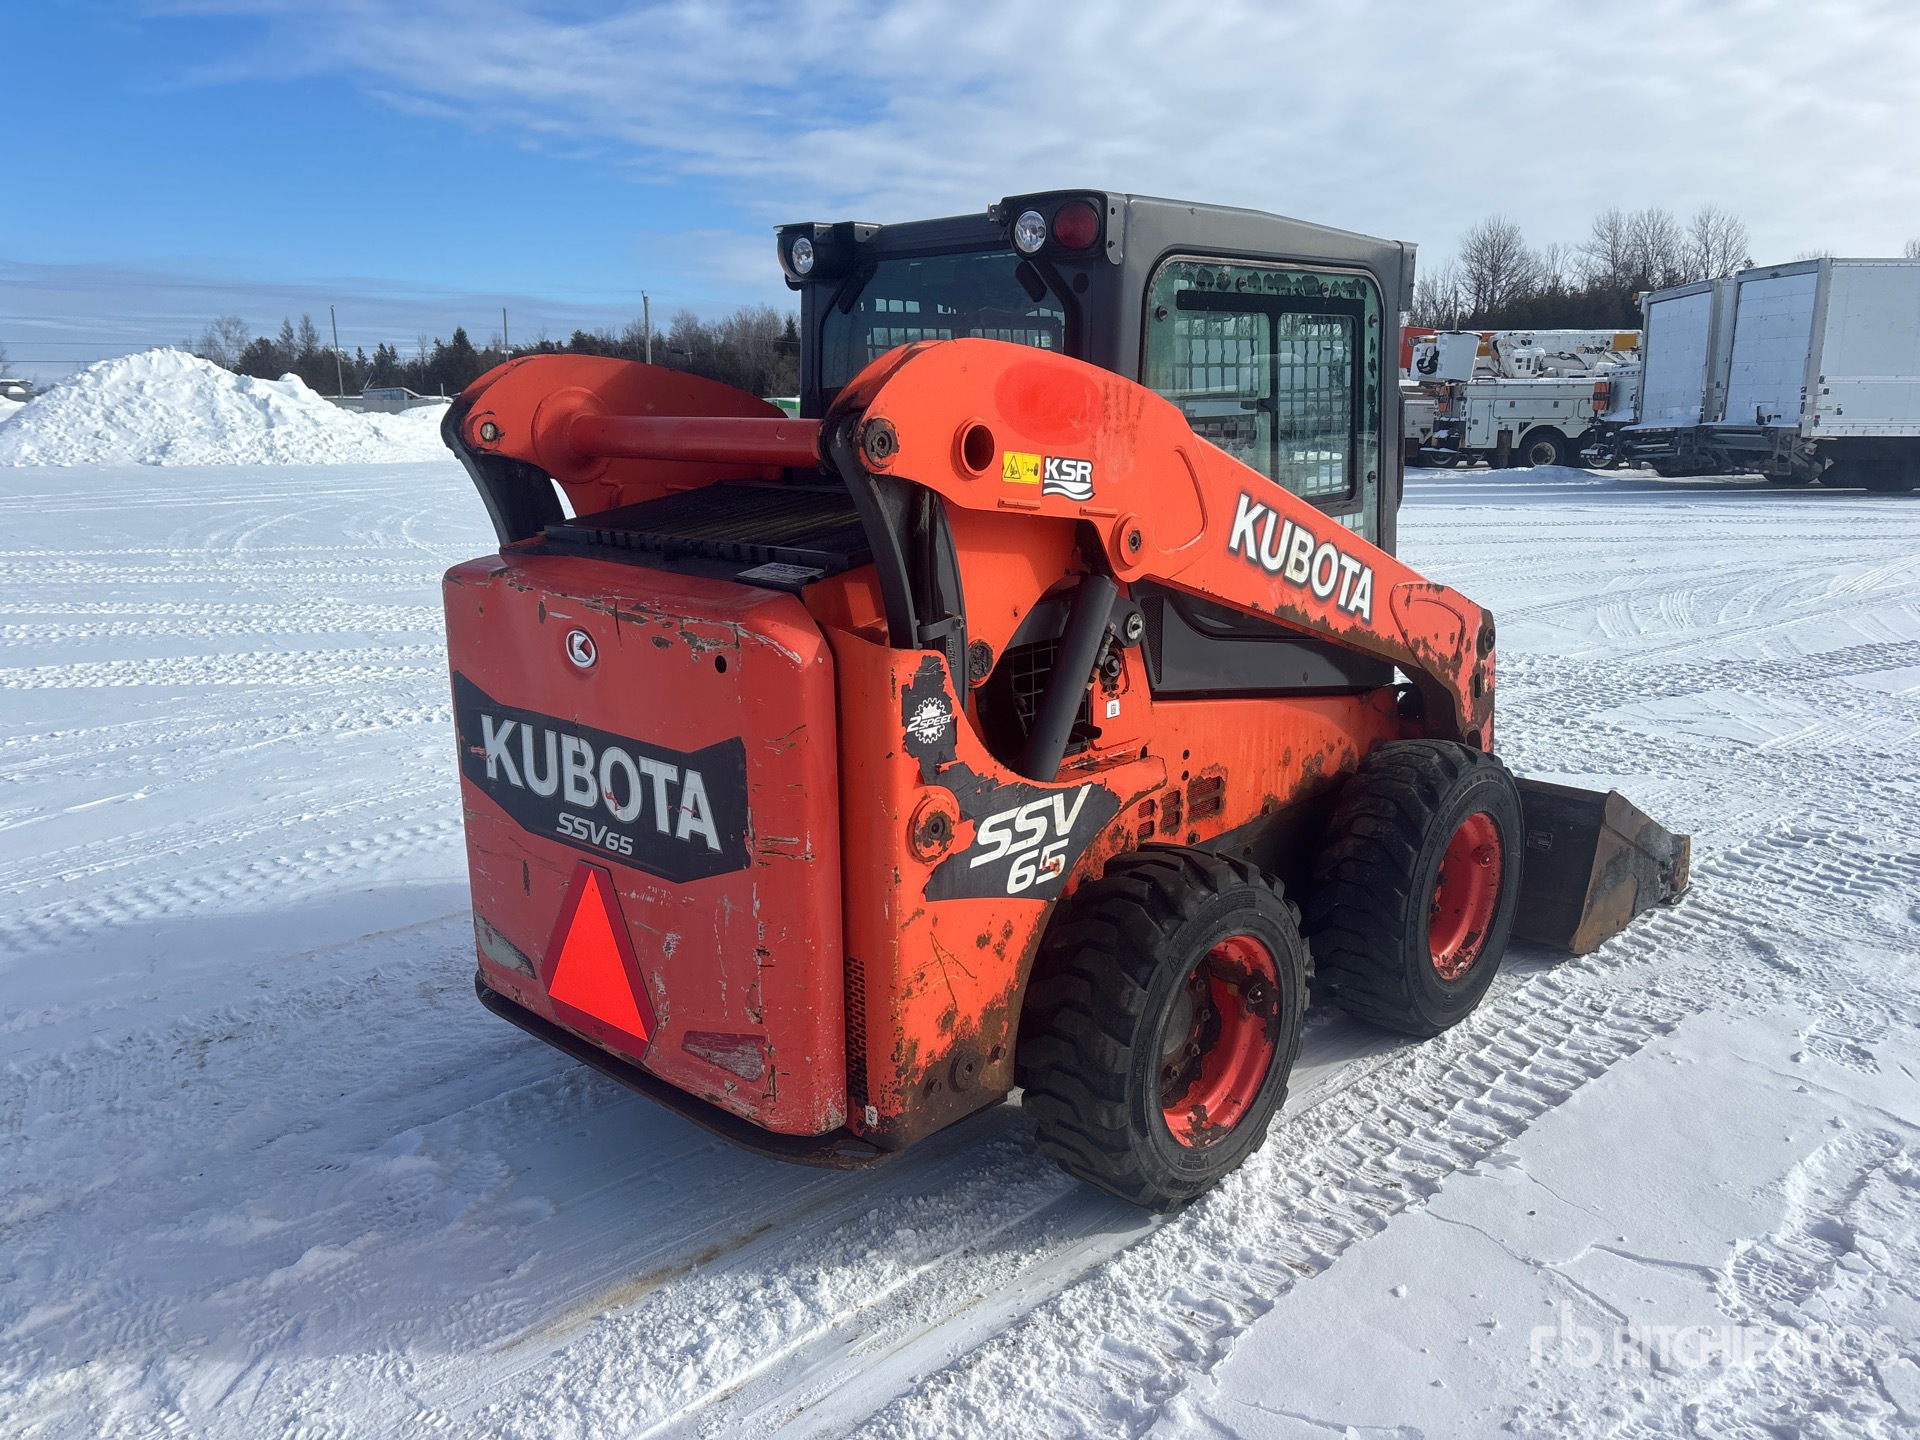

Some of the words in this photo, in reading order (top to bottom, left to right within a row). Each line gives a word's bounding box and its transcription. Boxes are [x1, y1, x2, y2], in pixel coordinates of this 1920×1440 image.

[1044, 457, 1092, 483] KSR
[1228, 493, 1373, 622] KUBOTA
[480, 714, 723, 853] KUBOTA
[556, 812, 634, 856] SSV65
[969, 784, 1092, 869] SSV
[1006, 838, 1069, 894] 65
